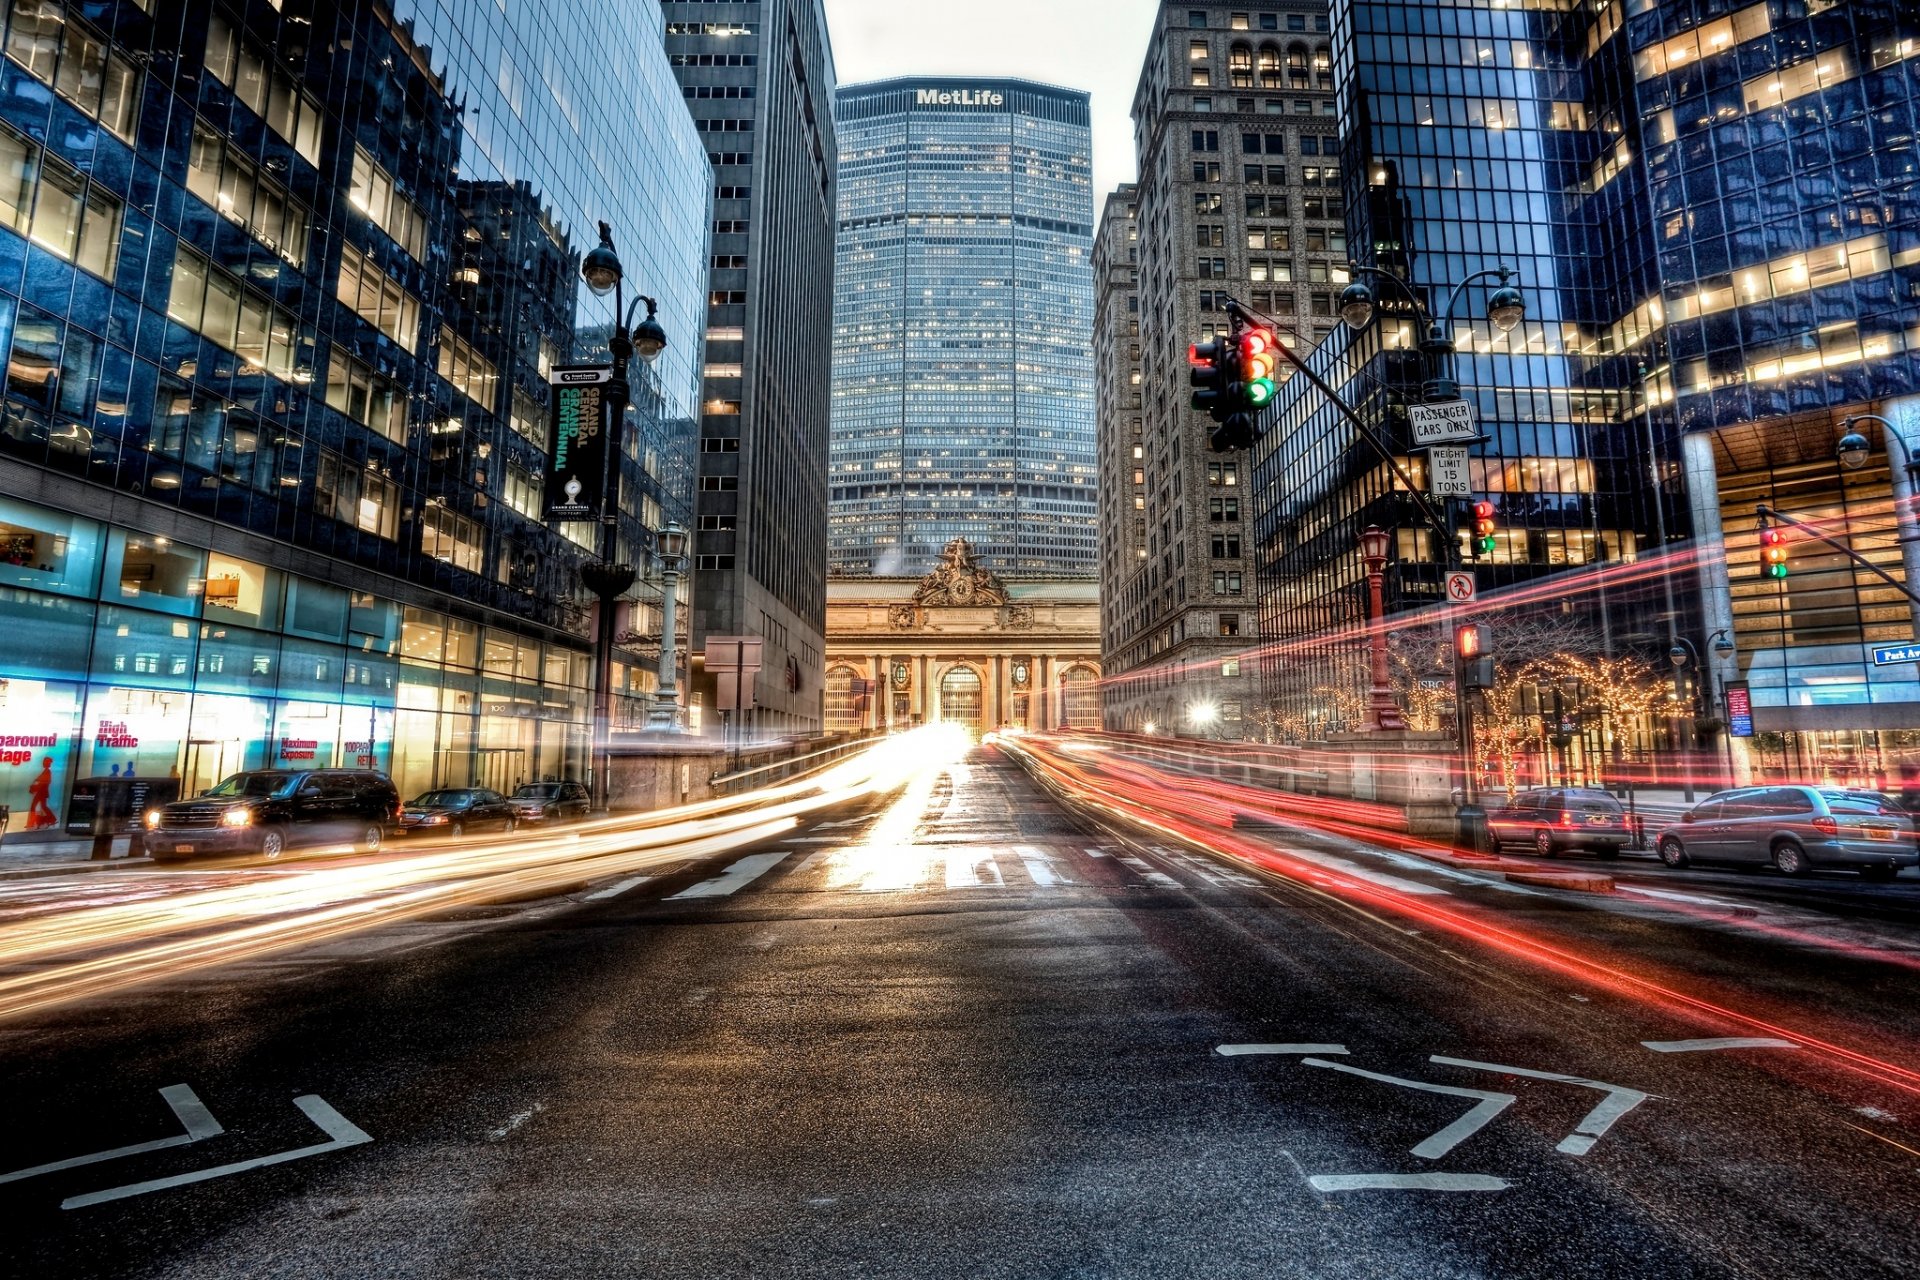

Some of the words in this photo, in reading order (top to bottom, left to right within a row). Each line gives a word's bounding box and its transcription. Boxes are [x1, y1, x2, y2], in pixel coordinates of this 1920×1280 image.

[917, 89, 1003, 105] MetLife
[568, 388, 580, 438] GRAND
[577, 387, 590, 448] CENTRAL
[588, 387, 600, 436] GRAND
[1414, 406, 1468, 421] PASSENGER
[555, 388, 570, 472] CENTENNIAL
[1417, 424, 1442, 436] CARS
[1446, 420, 1470, 432] ONLY
[1433, 450, 1466, 458] WEIGHT
[1438, 460, 1461, 468] LIMIT
[1444, 471, 1458, 479] 15
[1437, 482, 1467, 491] TONS
[1884, 651, 1906, 661] Park
[99, 720, 128, 737] High
[98, 734, 139, 748] Traffic
[281, 737, 318, 749] Maximum
[280, 749, 315, 761] Exposure
